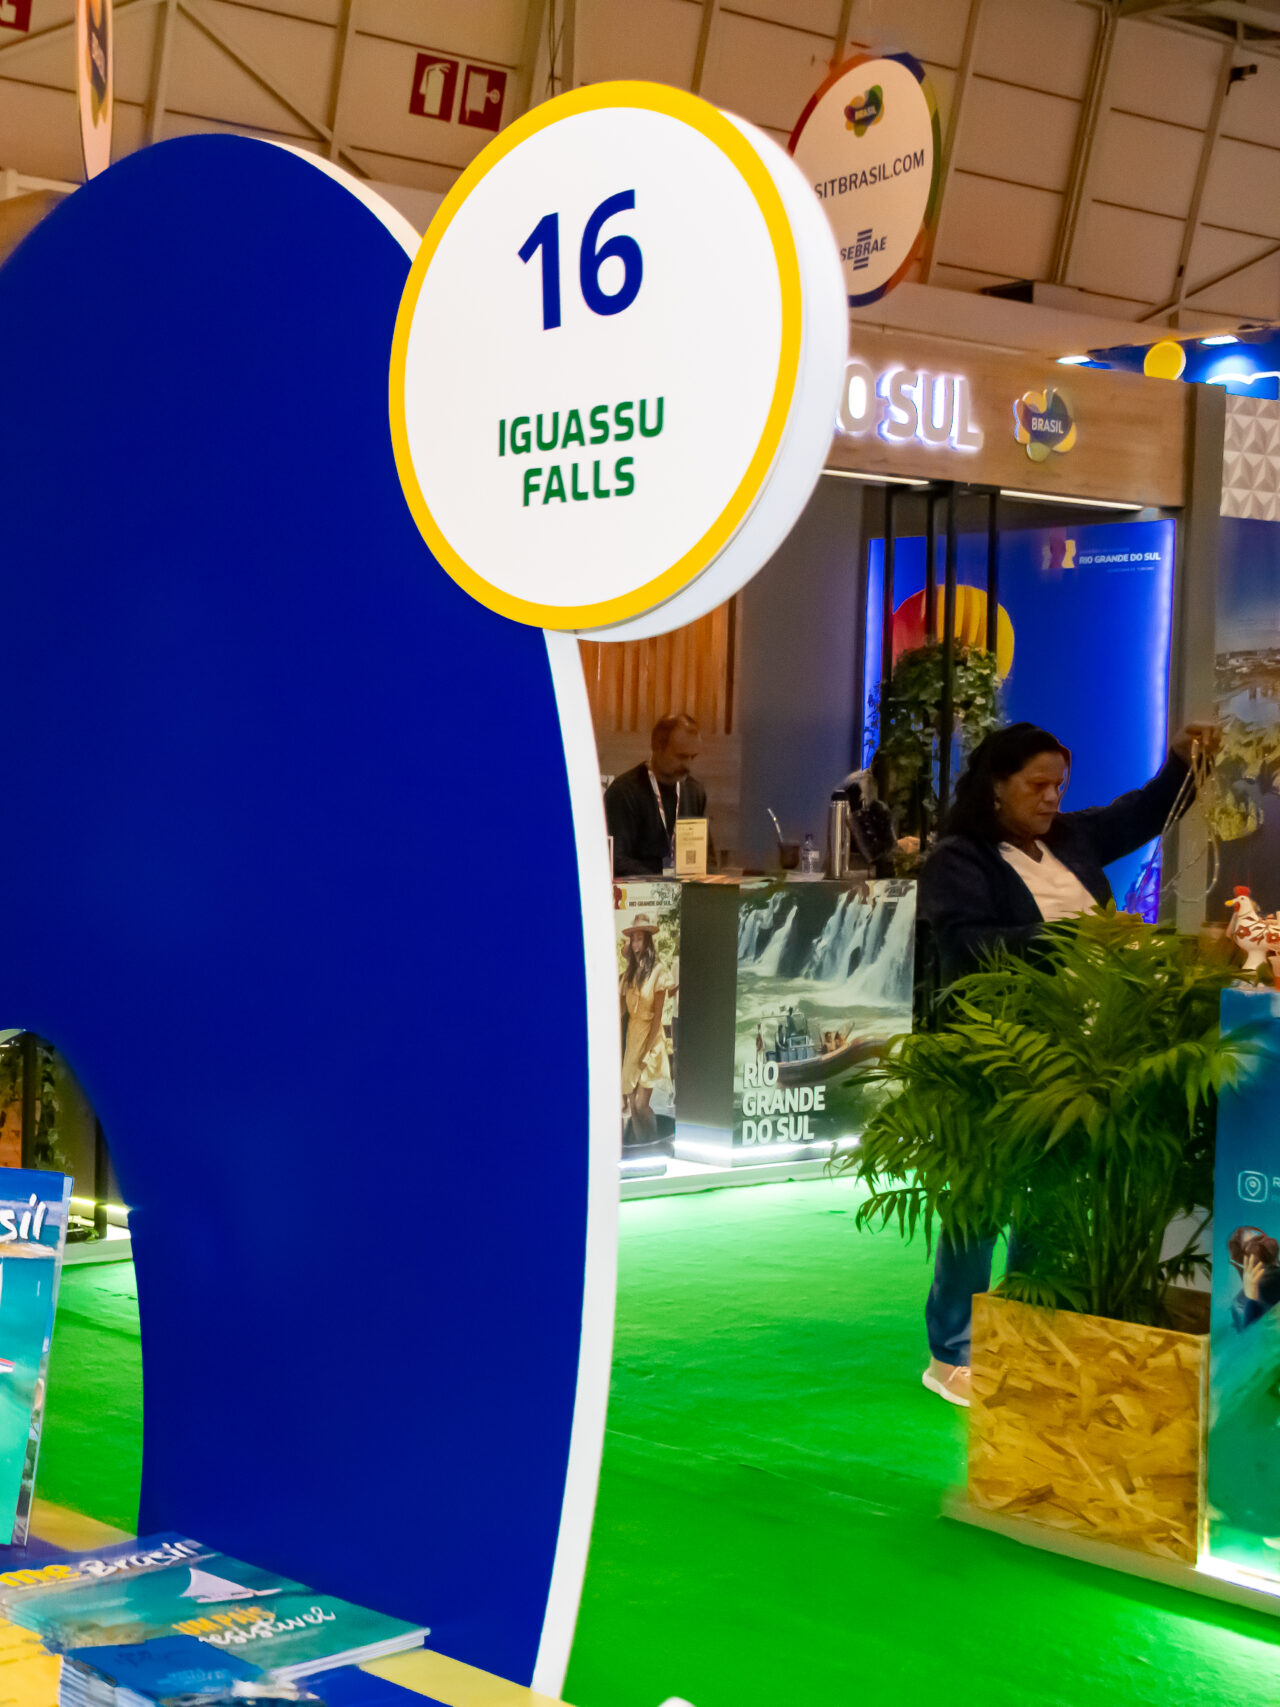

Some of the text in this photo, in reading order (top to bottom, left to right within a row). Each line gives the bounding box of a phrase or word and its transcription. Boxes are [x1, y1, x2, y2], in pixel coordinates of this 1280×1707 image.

[814, 149, 924, 200] SITBRASIL.COM
[517, 188, 644, 332] 16
[840, 236, 888, 262] SEBRAE
[839, 361, 985, 452] O SUL
[498, 396, 665, 457] IGUASSU
[1031, 417, 1064, 434] BRASIL
[522, 456, 635, 507] FALLS
[1094, 553, 1129, 564] GRANDE
[1130, 553, 1143, 562] DO
[1144, 552, 1161, 561] SUL
[743, 1060, 779, 1088] RIO
[742, 1085, 826, 1117] GRANDE
[742, 1115, 815, 1146] DO SUL
